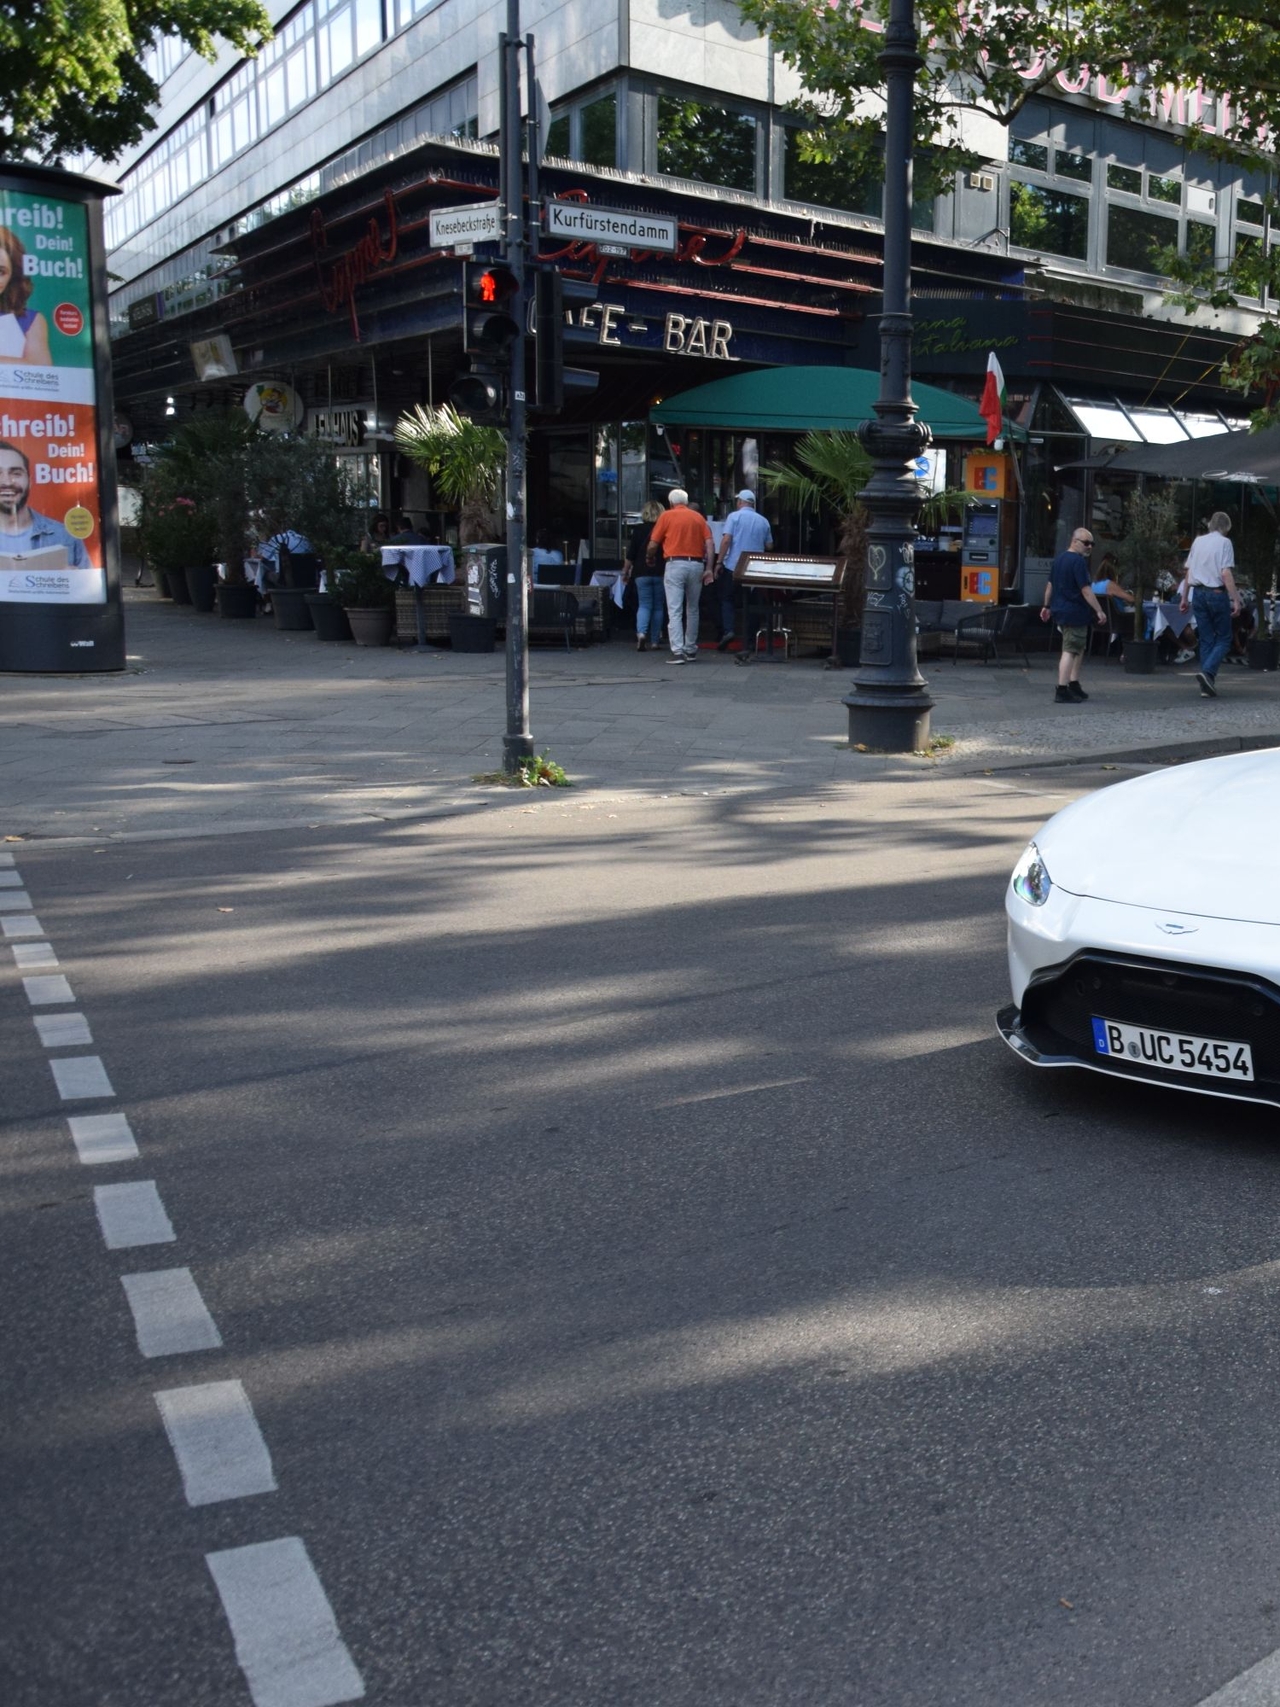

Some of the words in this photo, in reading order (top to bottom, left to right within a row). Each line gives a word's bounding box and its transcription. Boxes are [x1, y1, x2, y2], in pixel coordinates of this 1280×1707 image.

[435, 213, 496, 237] Knesebeckstraße
[553, 208, 669, 241] Kurfürstendamm
[35, 234, 74, 252] Dein!
[22, 254, 84, 279] Buch!
[664, 312, 733, 360] BAR
[0, 413, 75, 438] hreib!
[48, 443, 85, 458] Dein!
[35, 462, 95, 484] Buch!
[1107, 1025, 1125, 1054] B
[1139, 1032, 1175, 1064] UC
[1178, 1039, 1250, 1076] 5454
